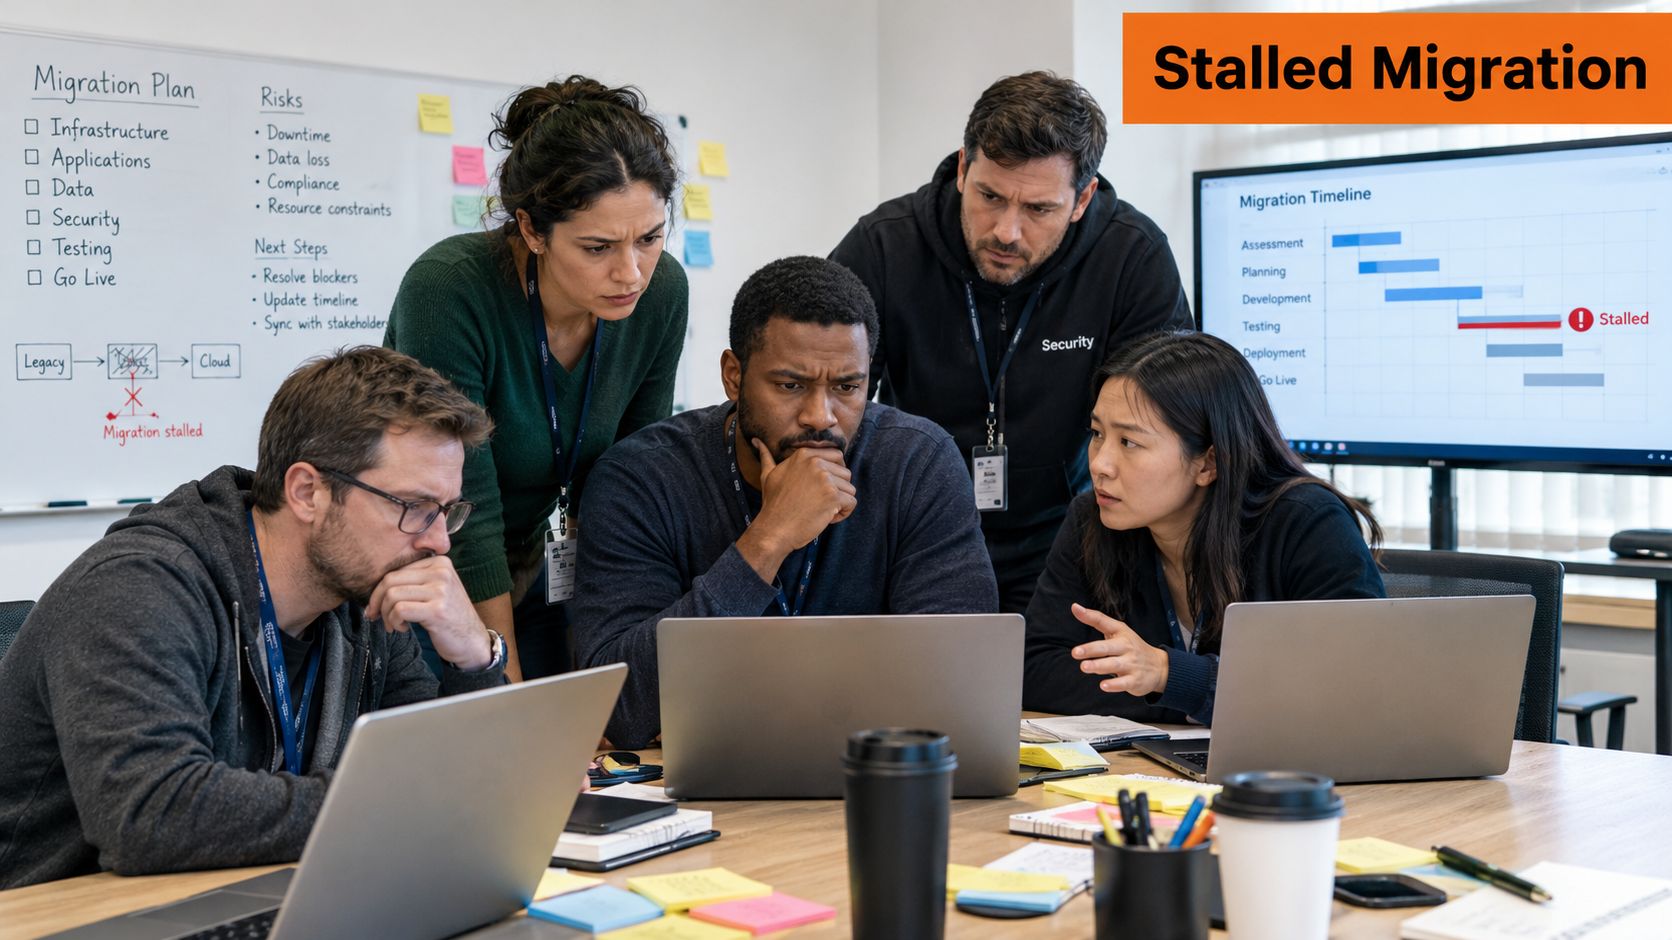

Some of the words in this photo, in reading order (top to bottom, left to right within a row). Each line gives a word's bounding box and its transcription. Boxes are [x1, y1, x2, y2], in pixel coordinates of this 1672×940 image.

[34, 64, 141, 104] Migration
[152, 71, 195, 100] Plan
[261, 86, 303, 109] Risks
[50, 117, 170, 142] Infrastructure
[267, 124, 332, 143] Downtime
[51, 147, 152, 174] Applications
[267, 148, 300, 166] Data
[307, 150, 330, 167] loss
[52, 178, 95, 198] Data
[267, 172, 340, 196] Compliance
[268, 197, 322, 215] Resource
[328, 201, 392, 217] constraints
[1240, 193, 1307, 212] Migration
[1310, 187, 1372, 204] Timeline
[52, 207, 121, 236] Security
[52, 237, 113, 265] Testing
[255, 237, 287, 254] Next
[294, 238, 328, 261] Steps
[1241, 238, 1304, 251] Assessment
[53, 267, 77, 288] Go
[85, 268, 117, 287] Live
[263, 267, 307, 284] Resolve
[313, 268, 359, 284] blockers
[1242, 266, 1287, 280] Planning
[264, 291, 307, 313] Update
[314, 291, 359, 307] timeline
[1242, 293, 1312, 307] Development
[264, 314, 293, 337] Sync
[298, 315, 322, 330] with
[328, 314, 388, 330] stakeholder
[1243, 320, 1281, 334] Testing
[1599, 311, 1650, 327] Stalled
[1041, 335, 1095, 352] Security
[200, 353, 231, 369] Cloud
[1243, 347, 1306, 361] Deployment
[24, 353, 65, 376] Legacy
[1259, 374, 1273, 386] Go
[1276, 374, 1297, 386] Live
[103, 424, 160, 447] Migration
[165, 423, 203, 438] stalled
